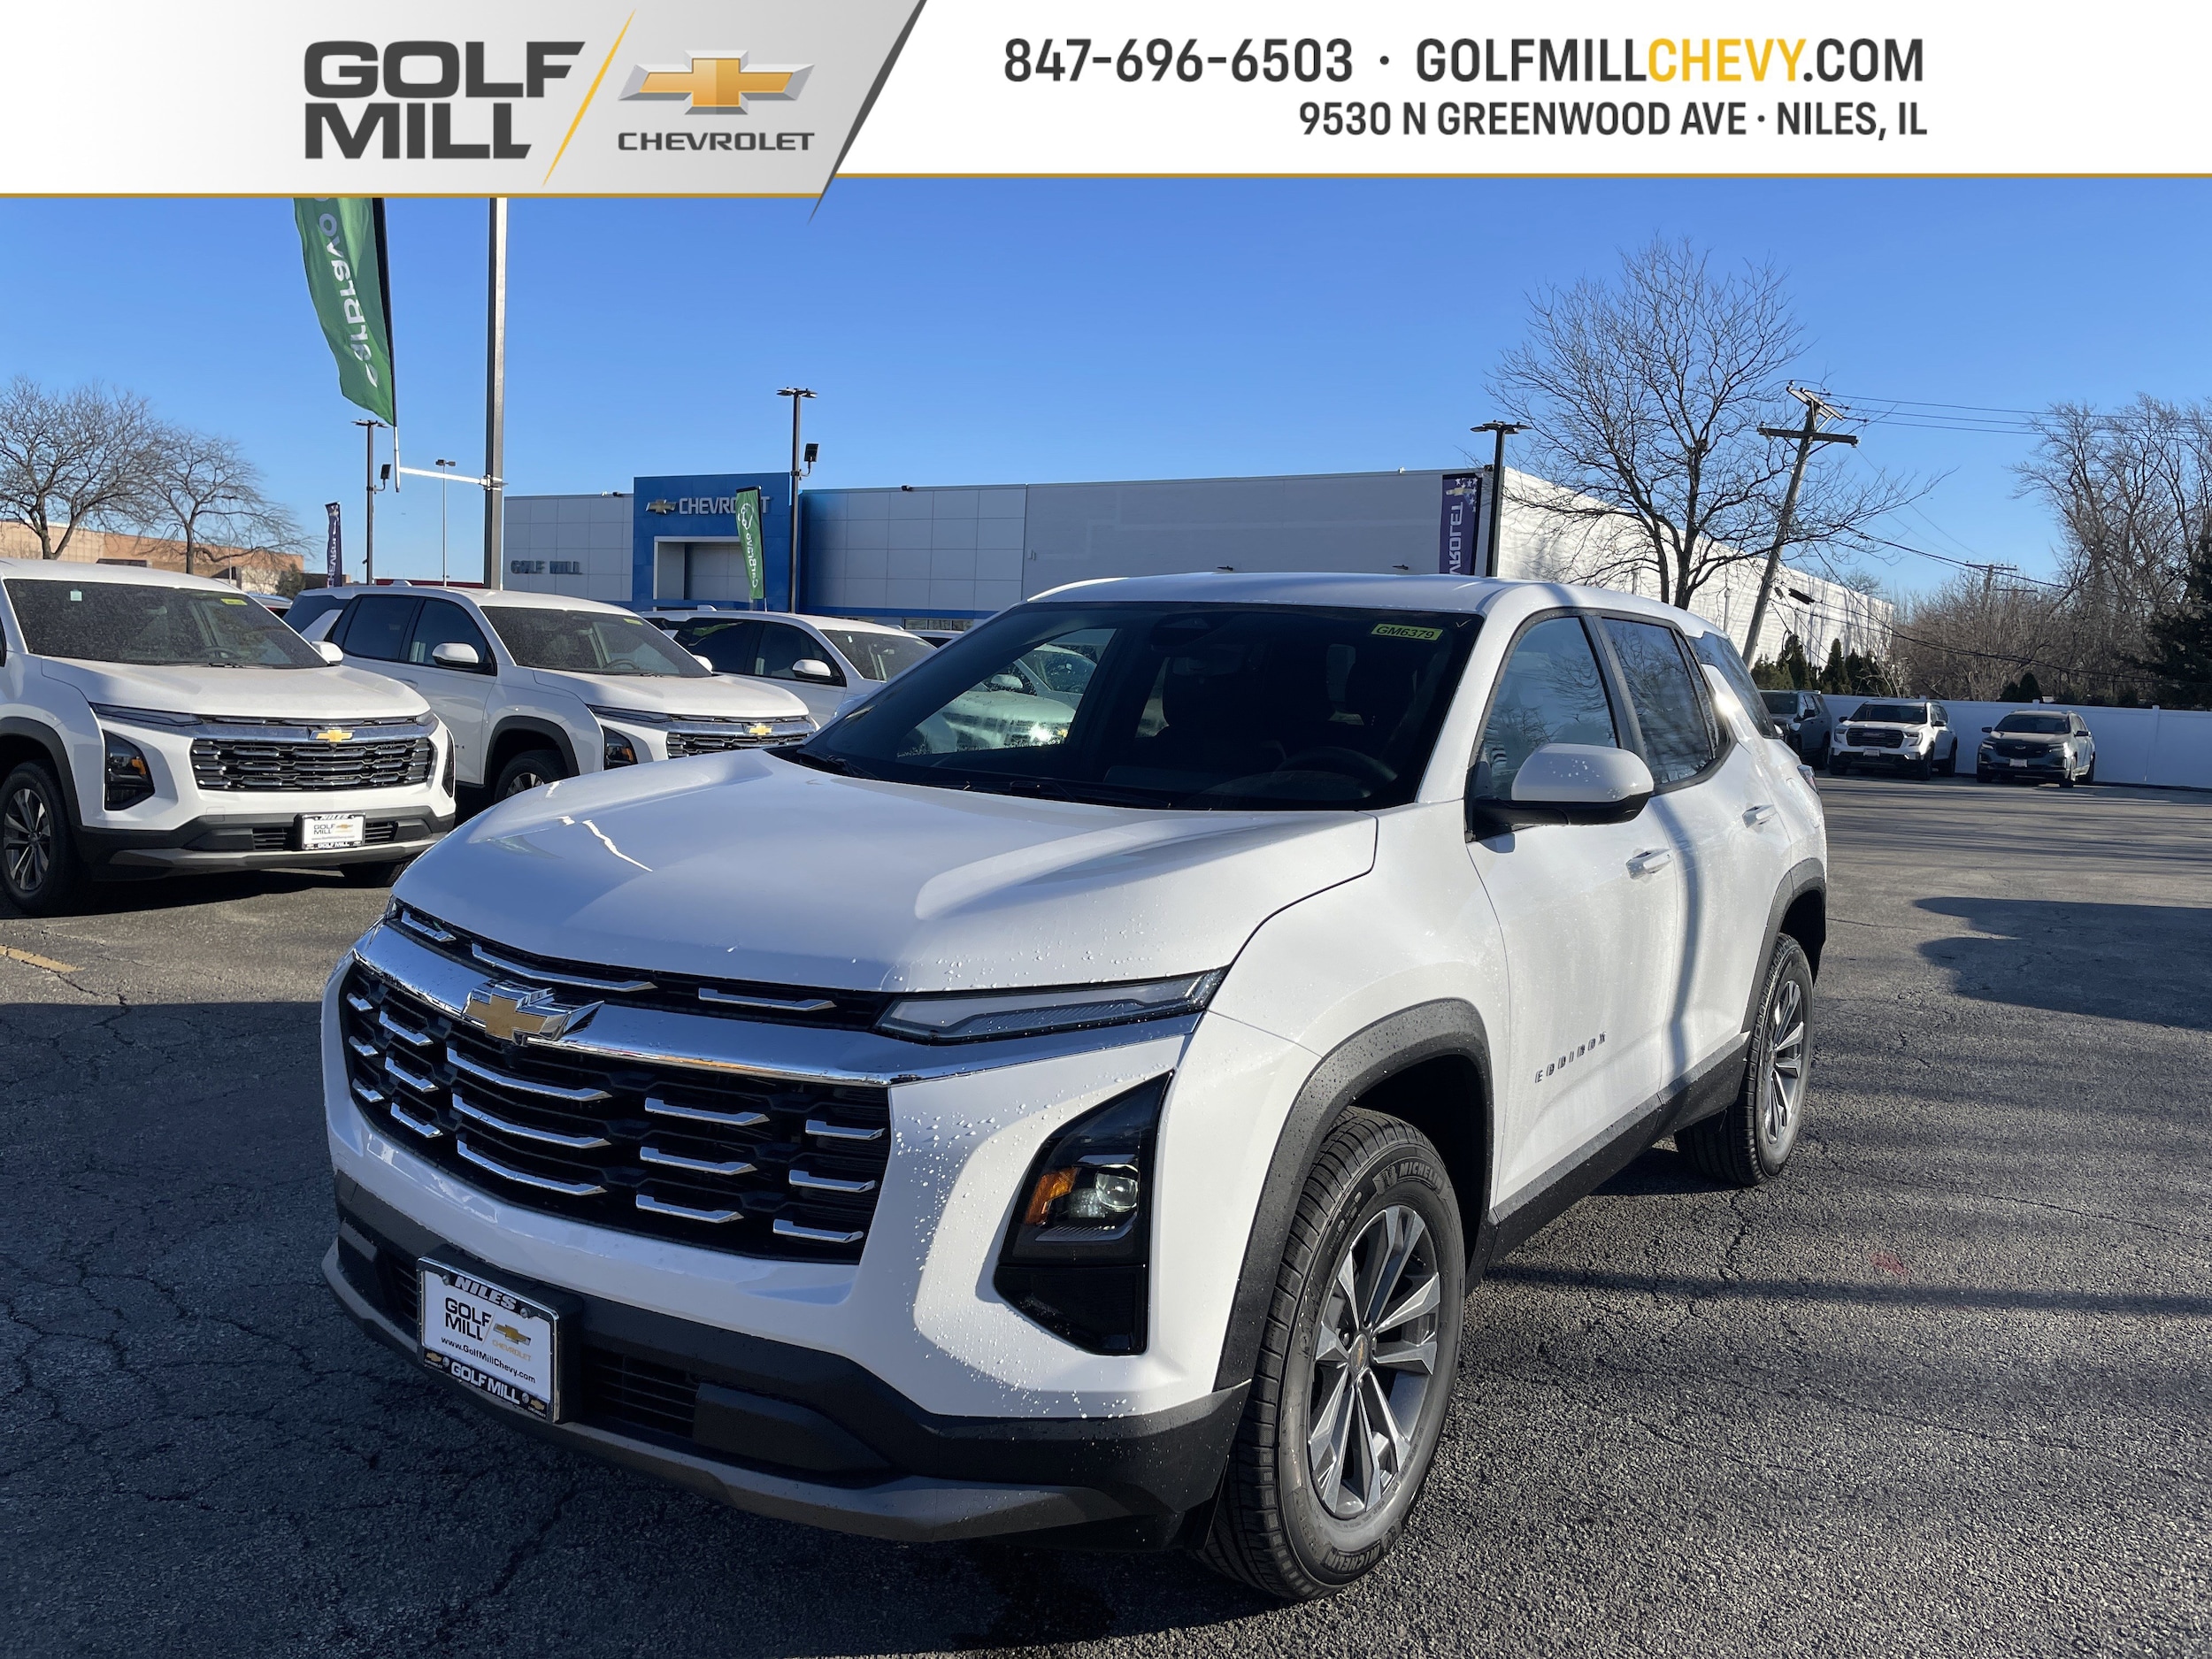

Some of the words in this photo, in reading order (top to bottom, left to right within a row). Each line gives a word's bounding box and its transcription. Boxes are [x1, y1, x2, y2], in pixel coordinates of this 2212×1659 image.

[679, 496, 770, 515] CHEVROT
[1376, 626, 1435, 639] GM6379
[1399, 1161, 1444, 1190] MICHELIN
[454, 1276, 517, 1310] NILES
[445, 1297, 492, 1327] GOLF
[445, 1313, 483, 1341] MILL
[441, 1336, 536, 1384] www.GolfMillChevy.com
[492, 1339, 532, 1362] CHEVROLET
[450, 1361, 487, 1387] GOLF
[487, 1379, 520, 1405] MILL
[1325, 1543, 1381, 1571] MICHELIN
